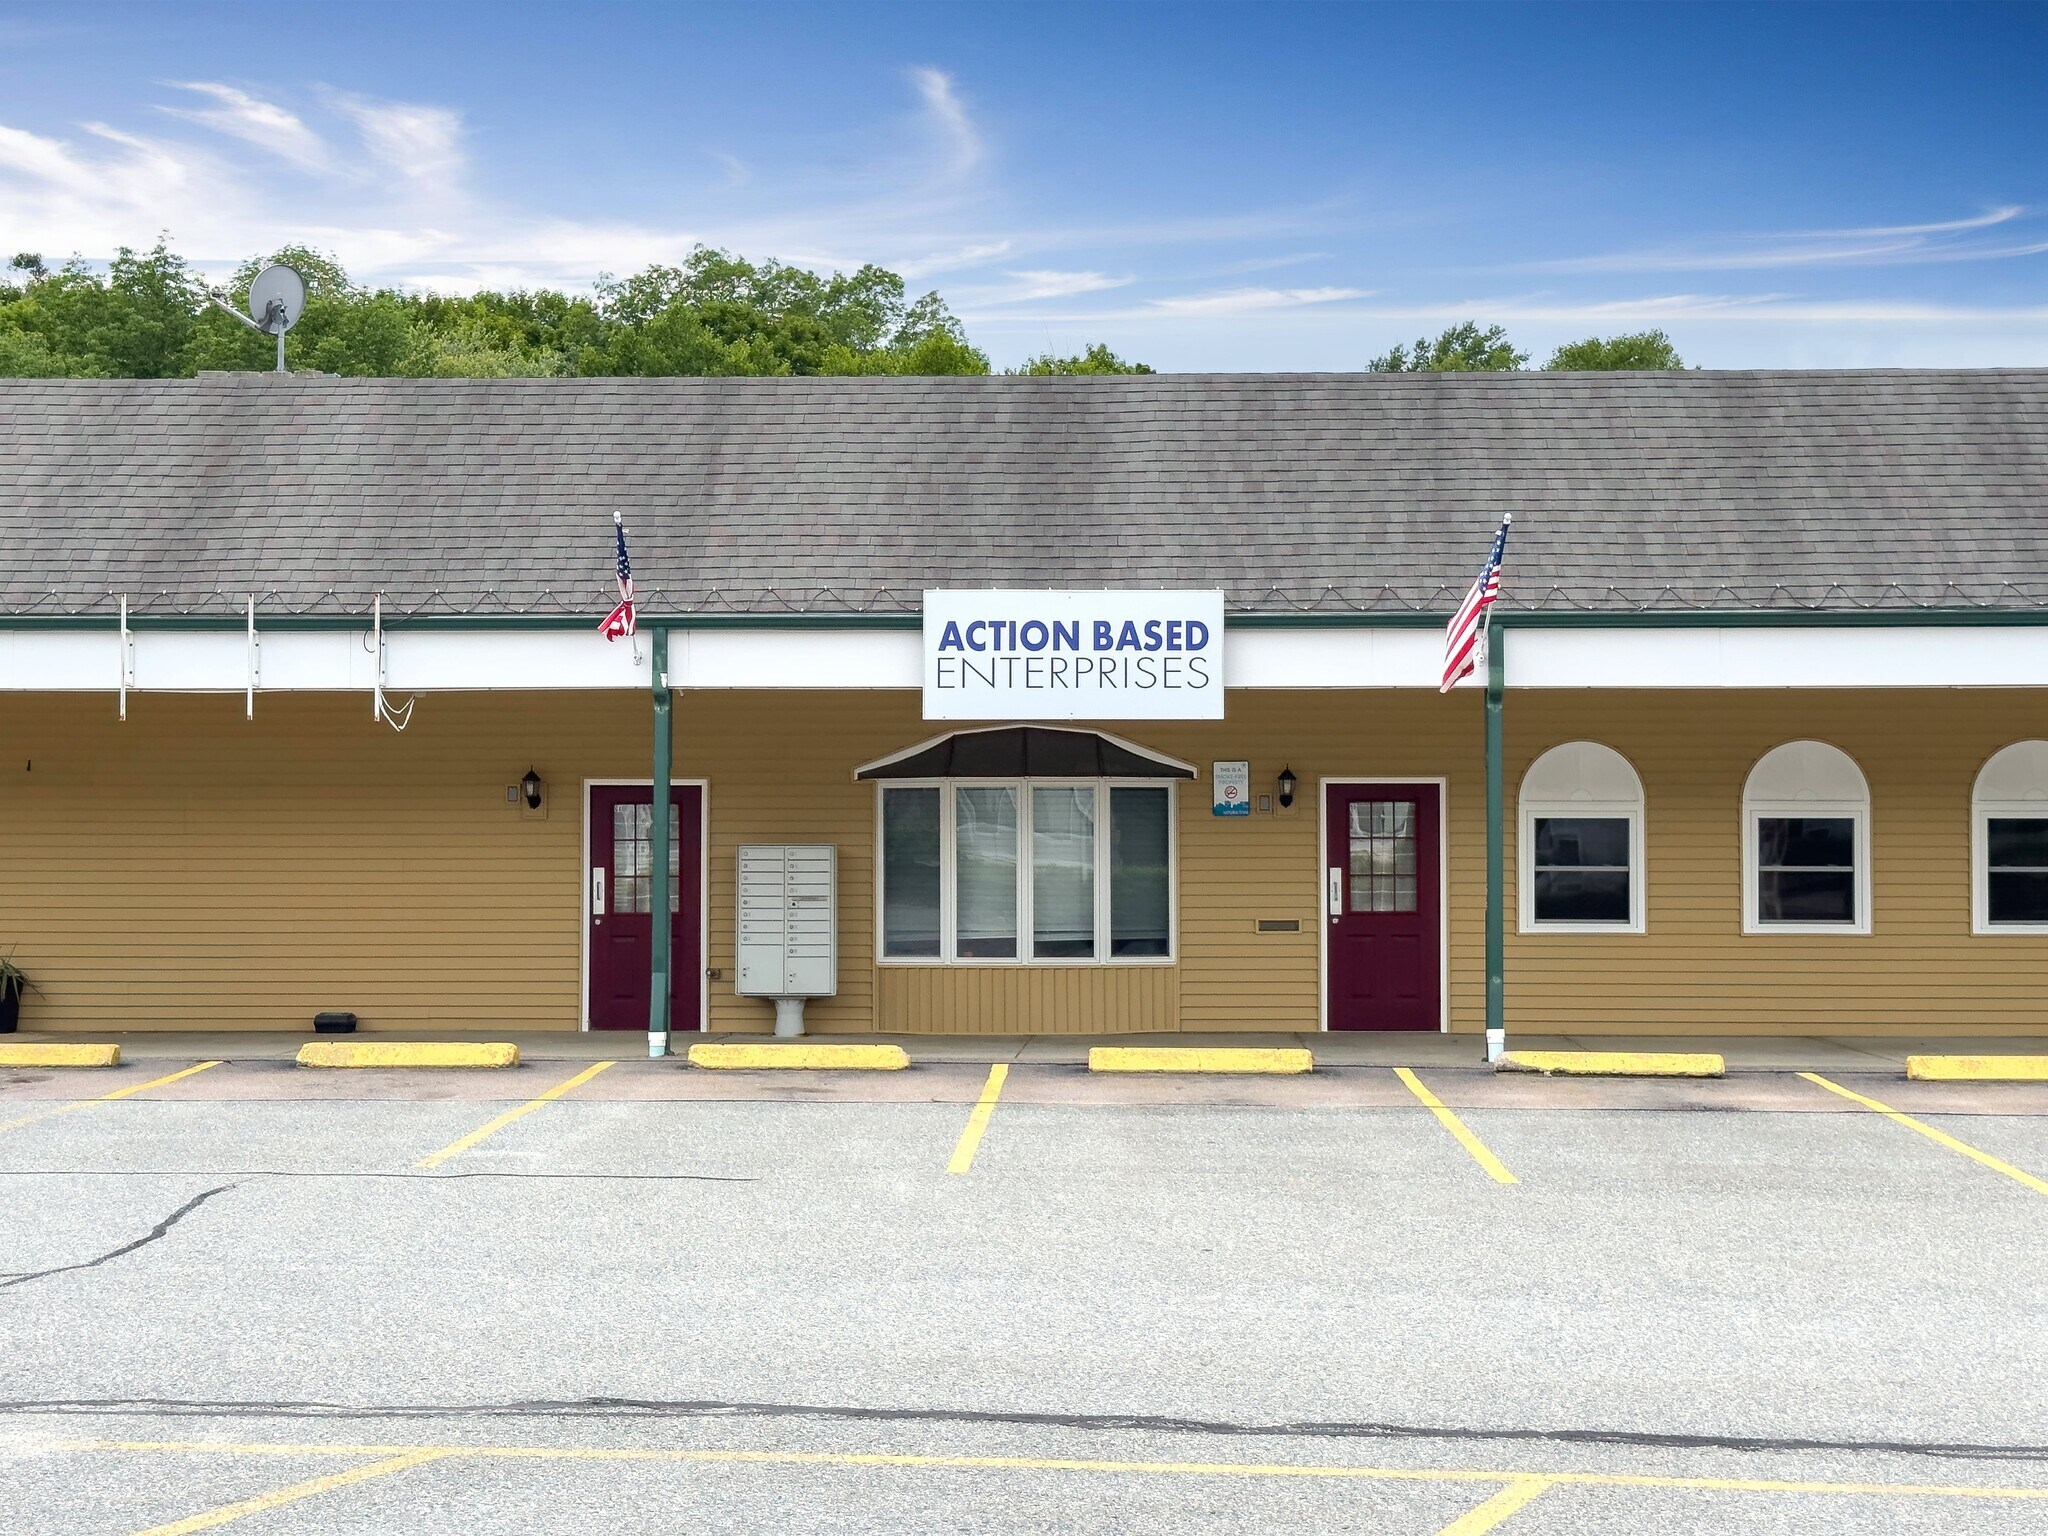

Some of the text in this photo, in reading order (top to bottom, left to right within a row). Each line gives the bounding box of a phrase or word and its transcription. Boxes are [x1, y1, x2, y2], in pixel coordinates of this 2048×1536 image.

[938, 619, 1209, 652] ACTION BASED
[937, 656, 1209, 689] ENTERPRISES
